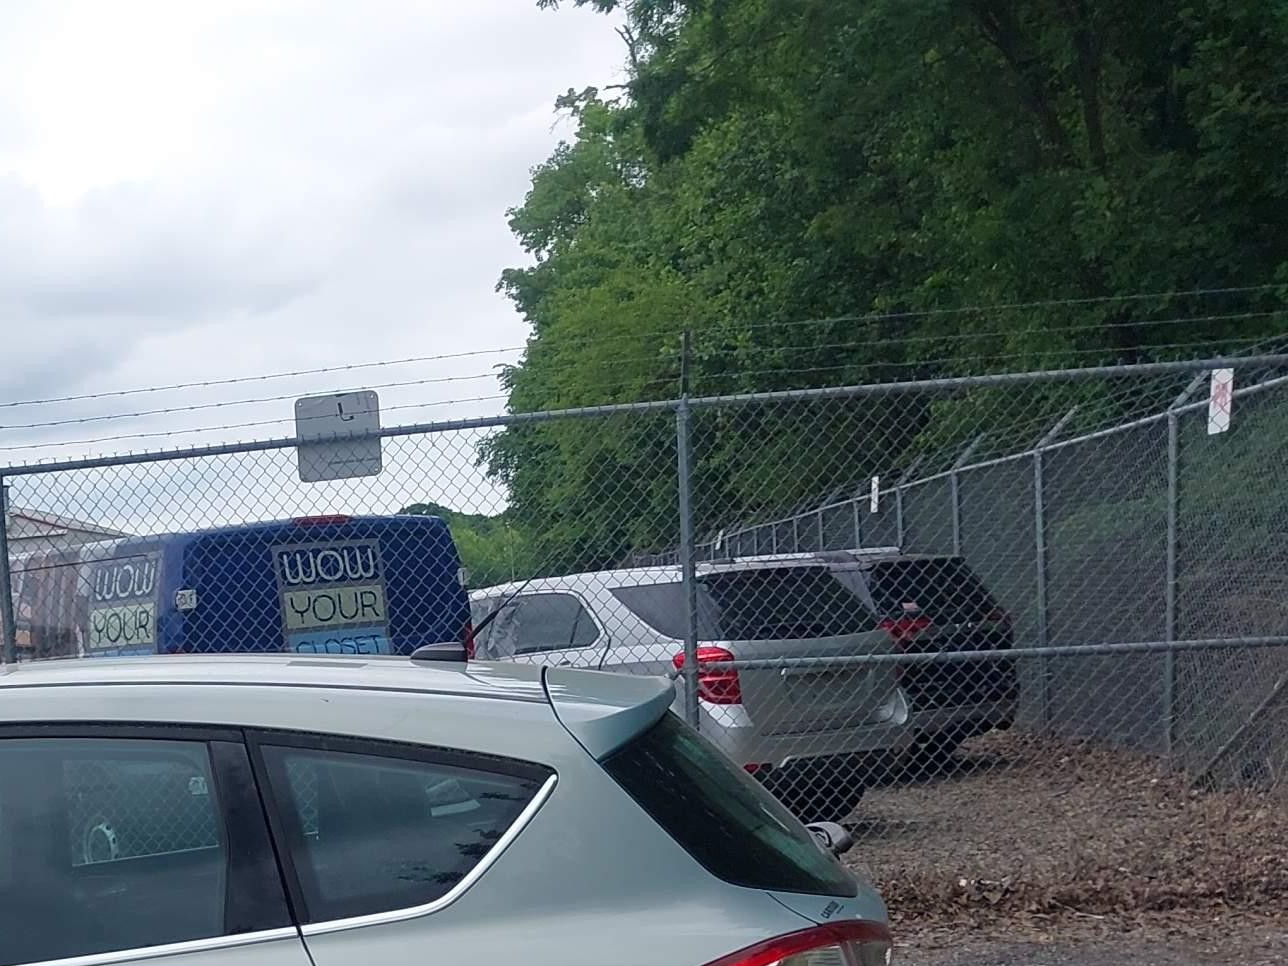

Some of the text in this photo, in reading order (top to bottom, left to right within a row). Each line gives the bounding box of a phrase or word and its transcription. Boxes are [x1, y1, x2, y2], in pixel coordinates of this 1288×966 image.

[95, 562, 155, 600] WOW
[282, 548, 374, 583] WOW
[289, 590, 379, 624] YOUR
[93, 610, 150, 643] YOUR
